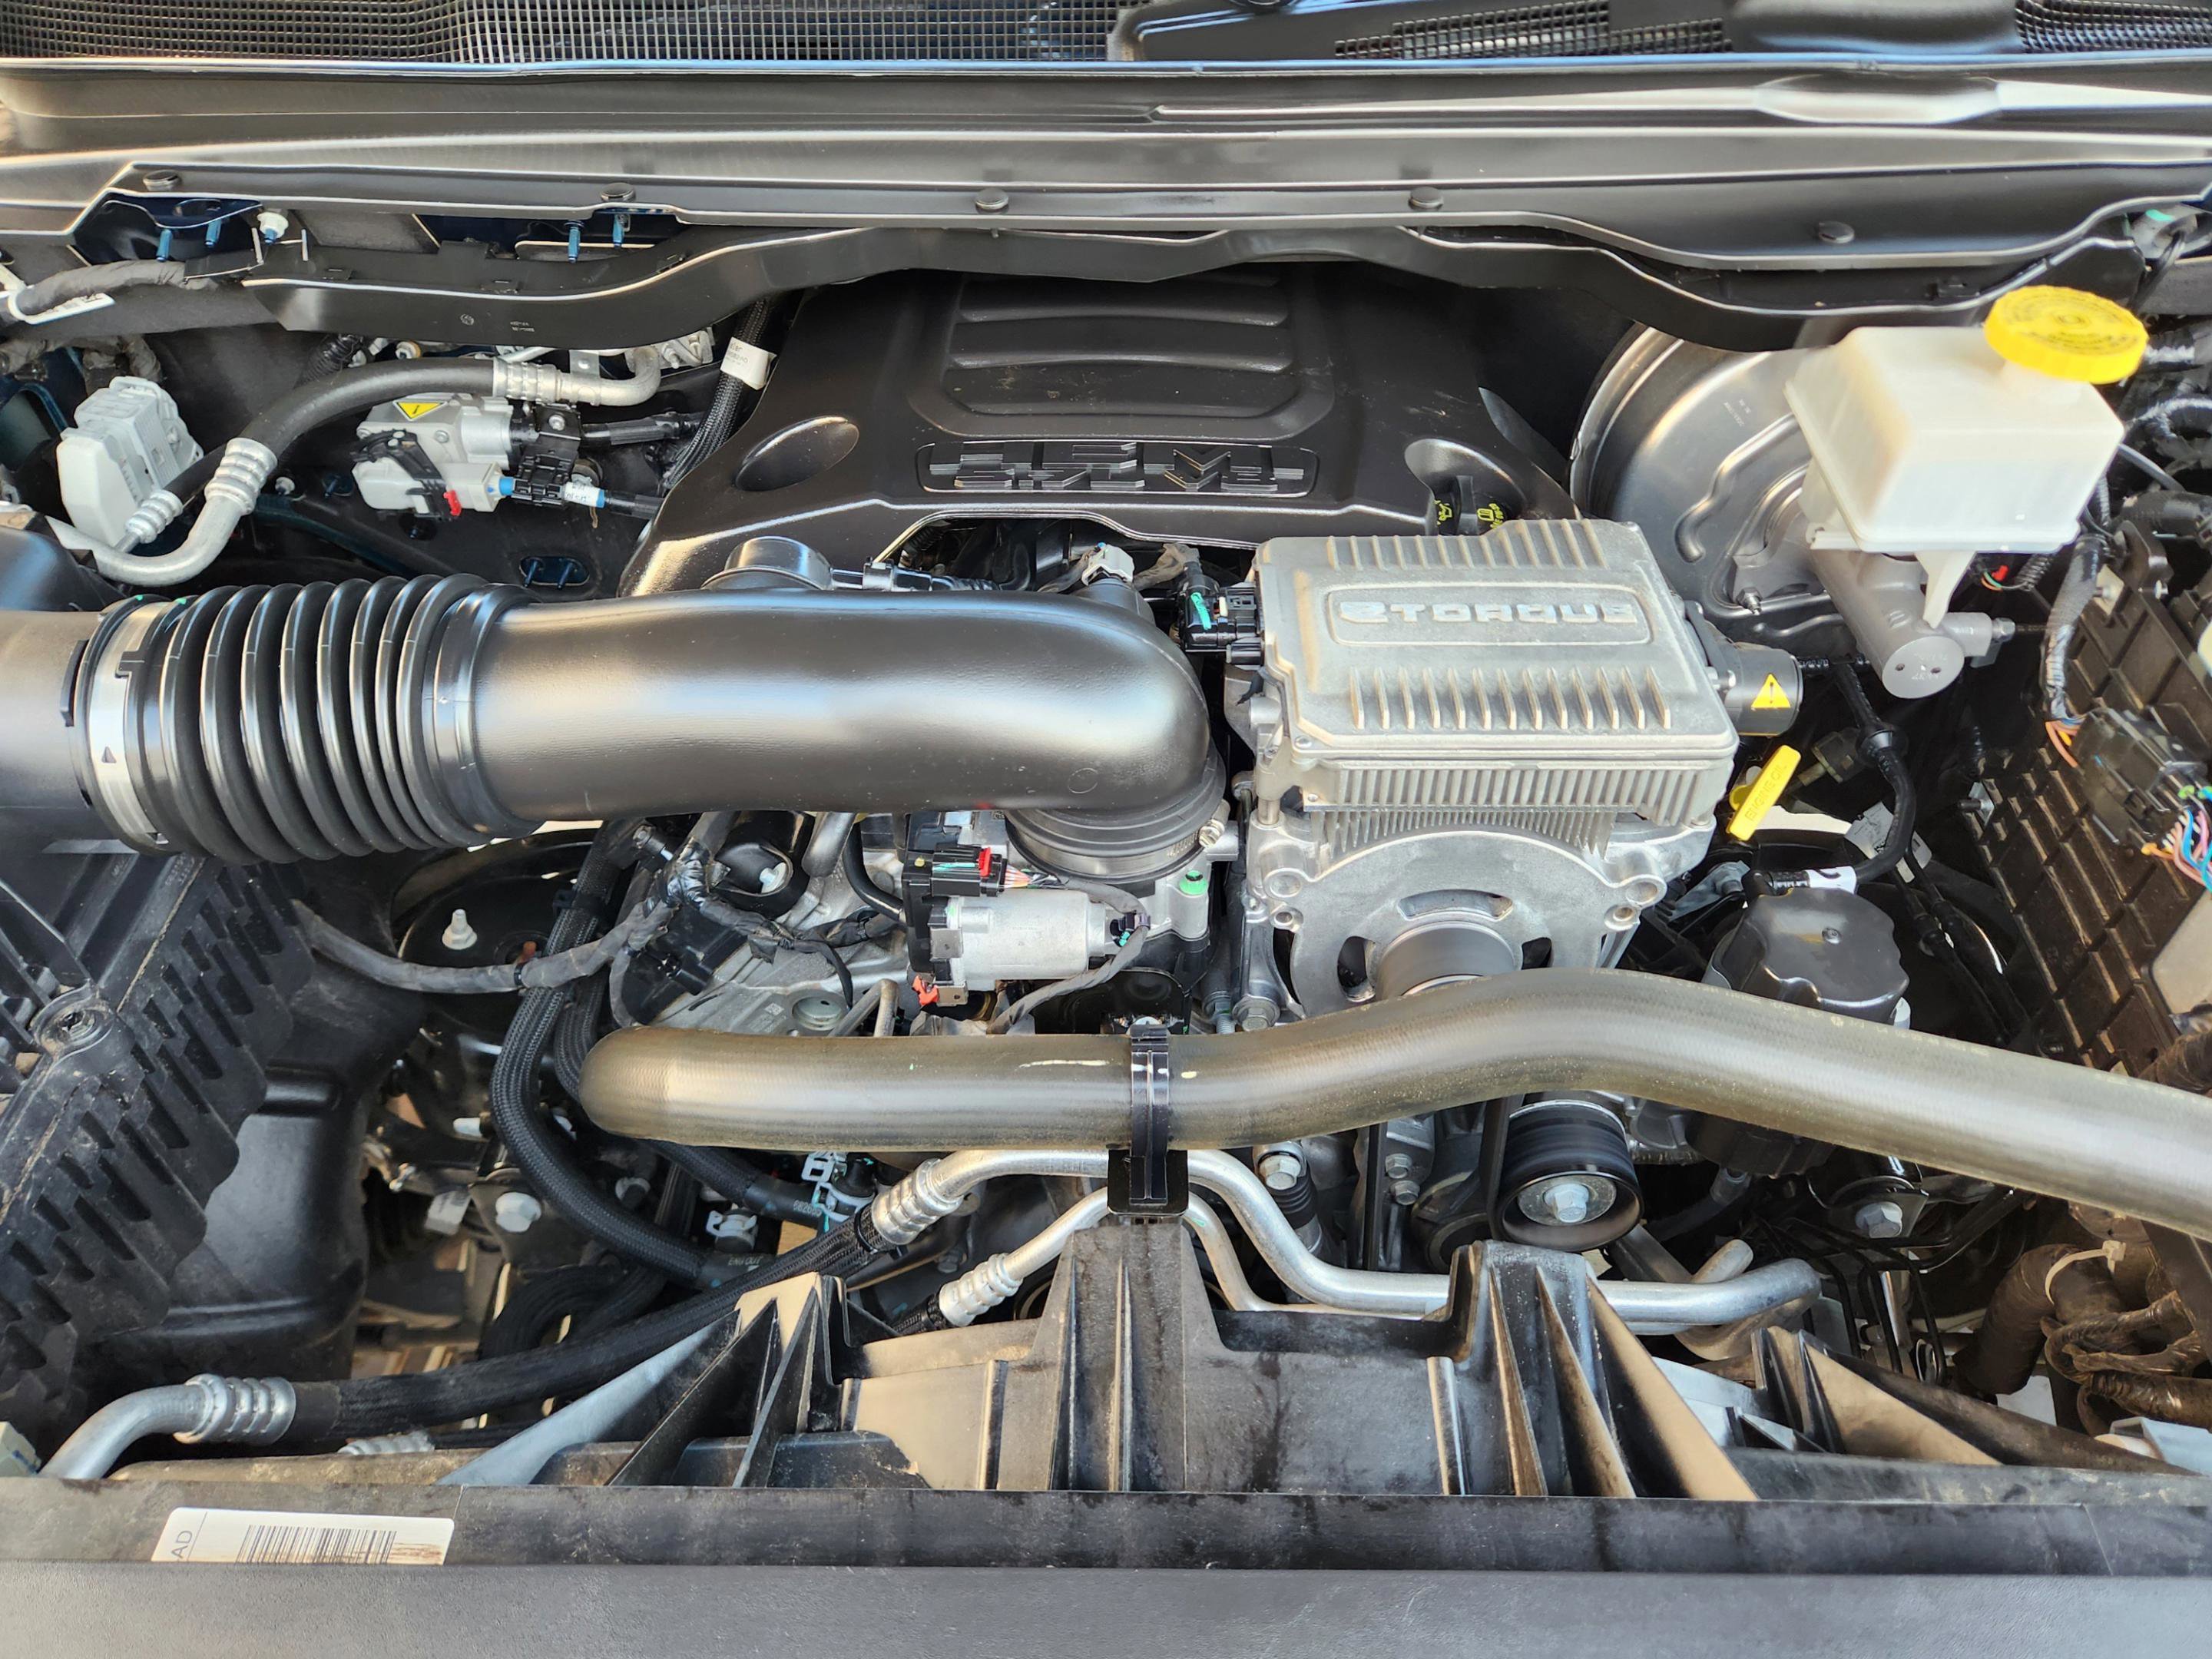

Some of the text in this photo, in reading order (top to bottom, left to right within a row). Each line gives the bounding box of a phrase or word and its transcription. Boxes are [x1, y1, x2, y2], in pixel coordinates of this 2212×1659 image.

[1744, 764, 1787, 822] ENGINE OIL
[171, 1529, 194, 1559] AD
